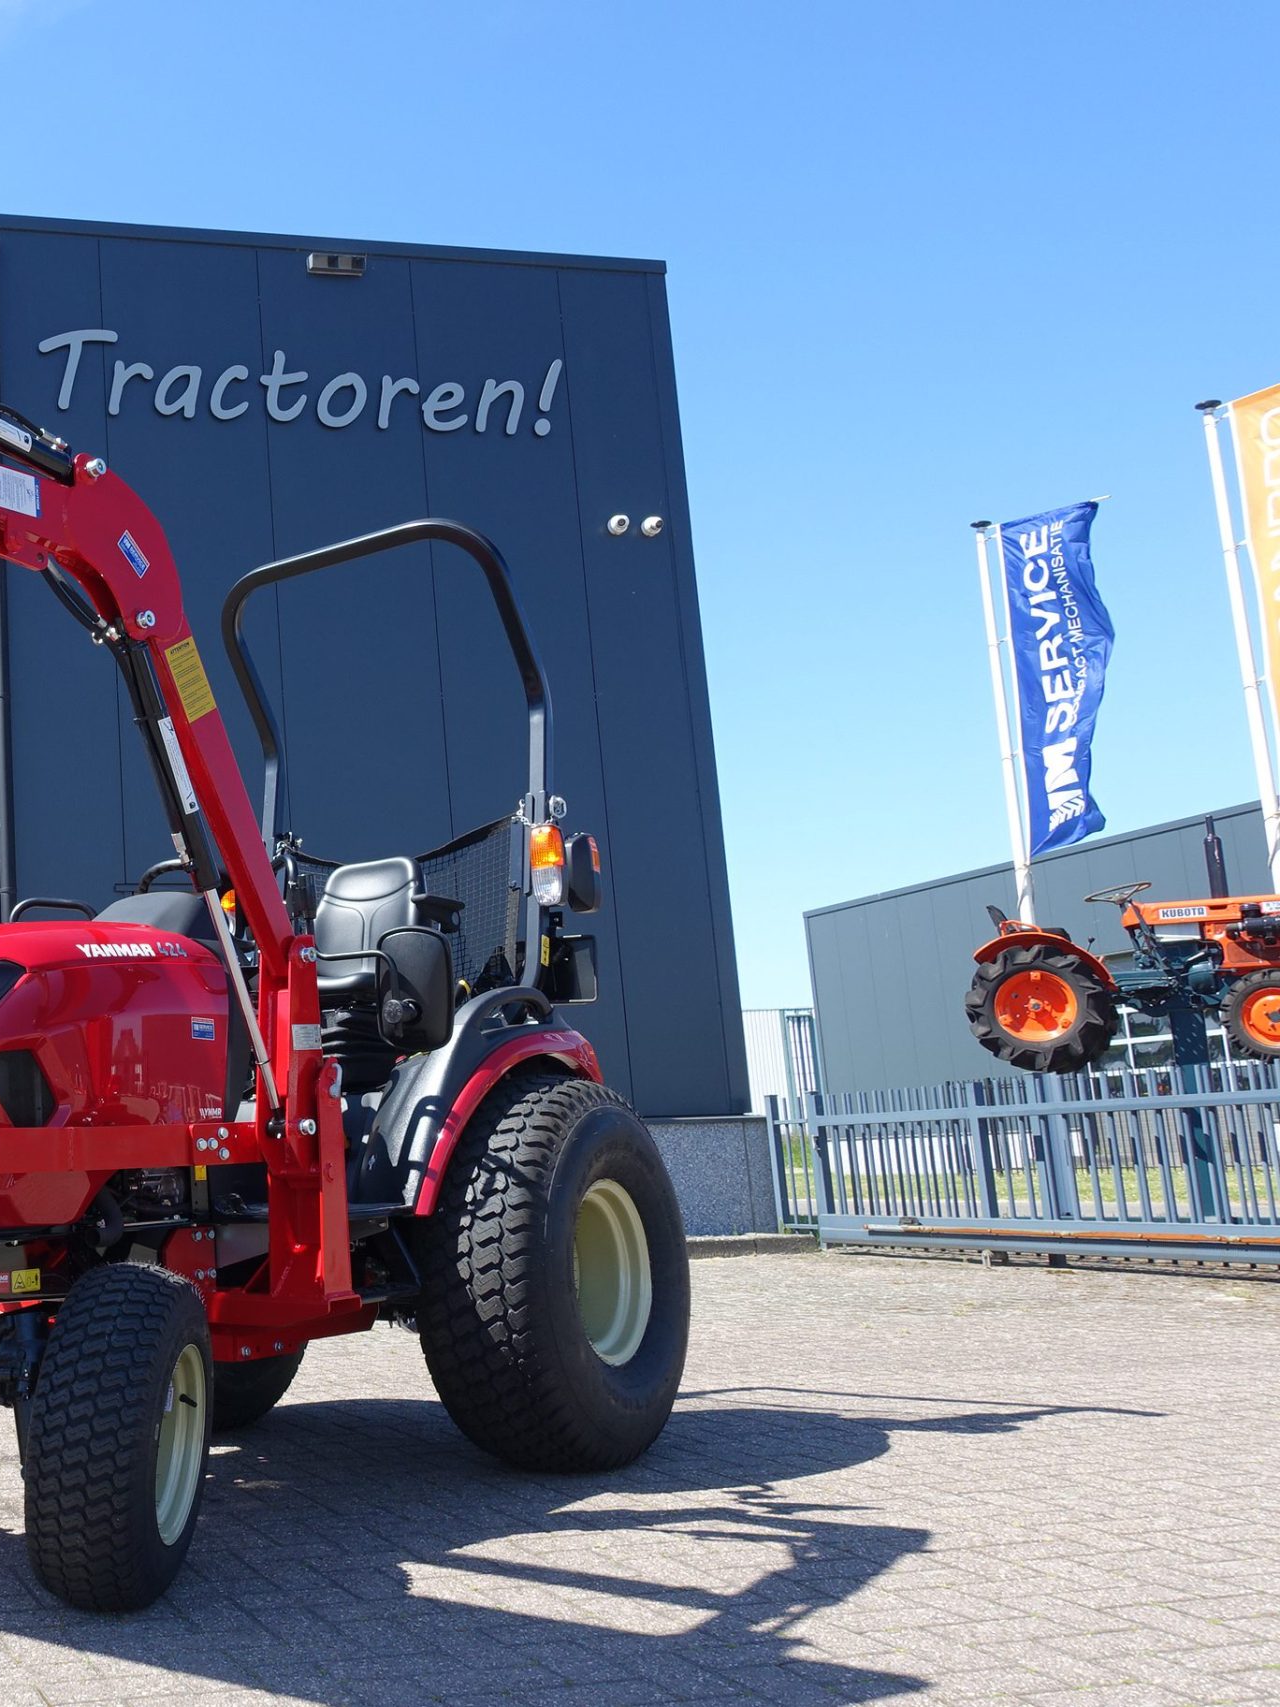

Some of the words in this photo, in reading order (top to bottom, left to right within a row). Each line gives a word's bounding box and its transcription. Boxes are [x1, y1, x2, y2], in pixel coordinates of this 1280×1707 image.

[38, 328, 563, 437] Tractoren!
[1020, 524, 1072, 734] SERVICE
[1049, 519, 1082, 643] MECHANISATIE
[75, 943, 156, 958] YANMAR
[156, 941, 188, 957] 424
[1161, 907, 1205, 918] KUBOTA
